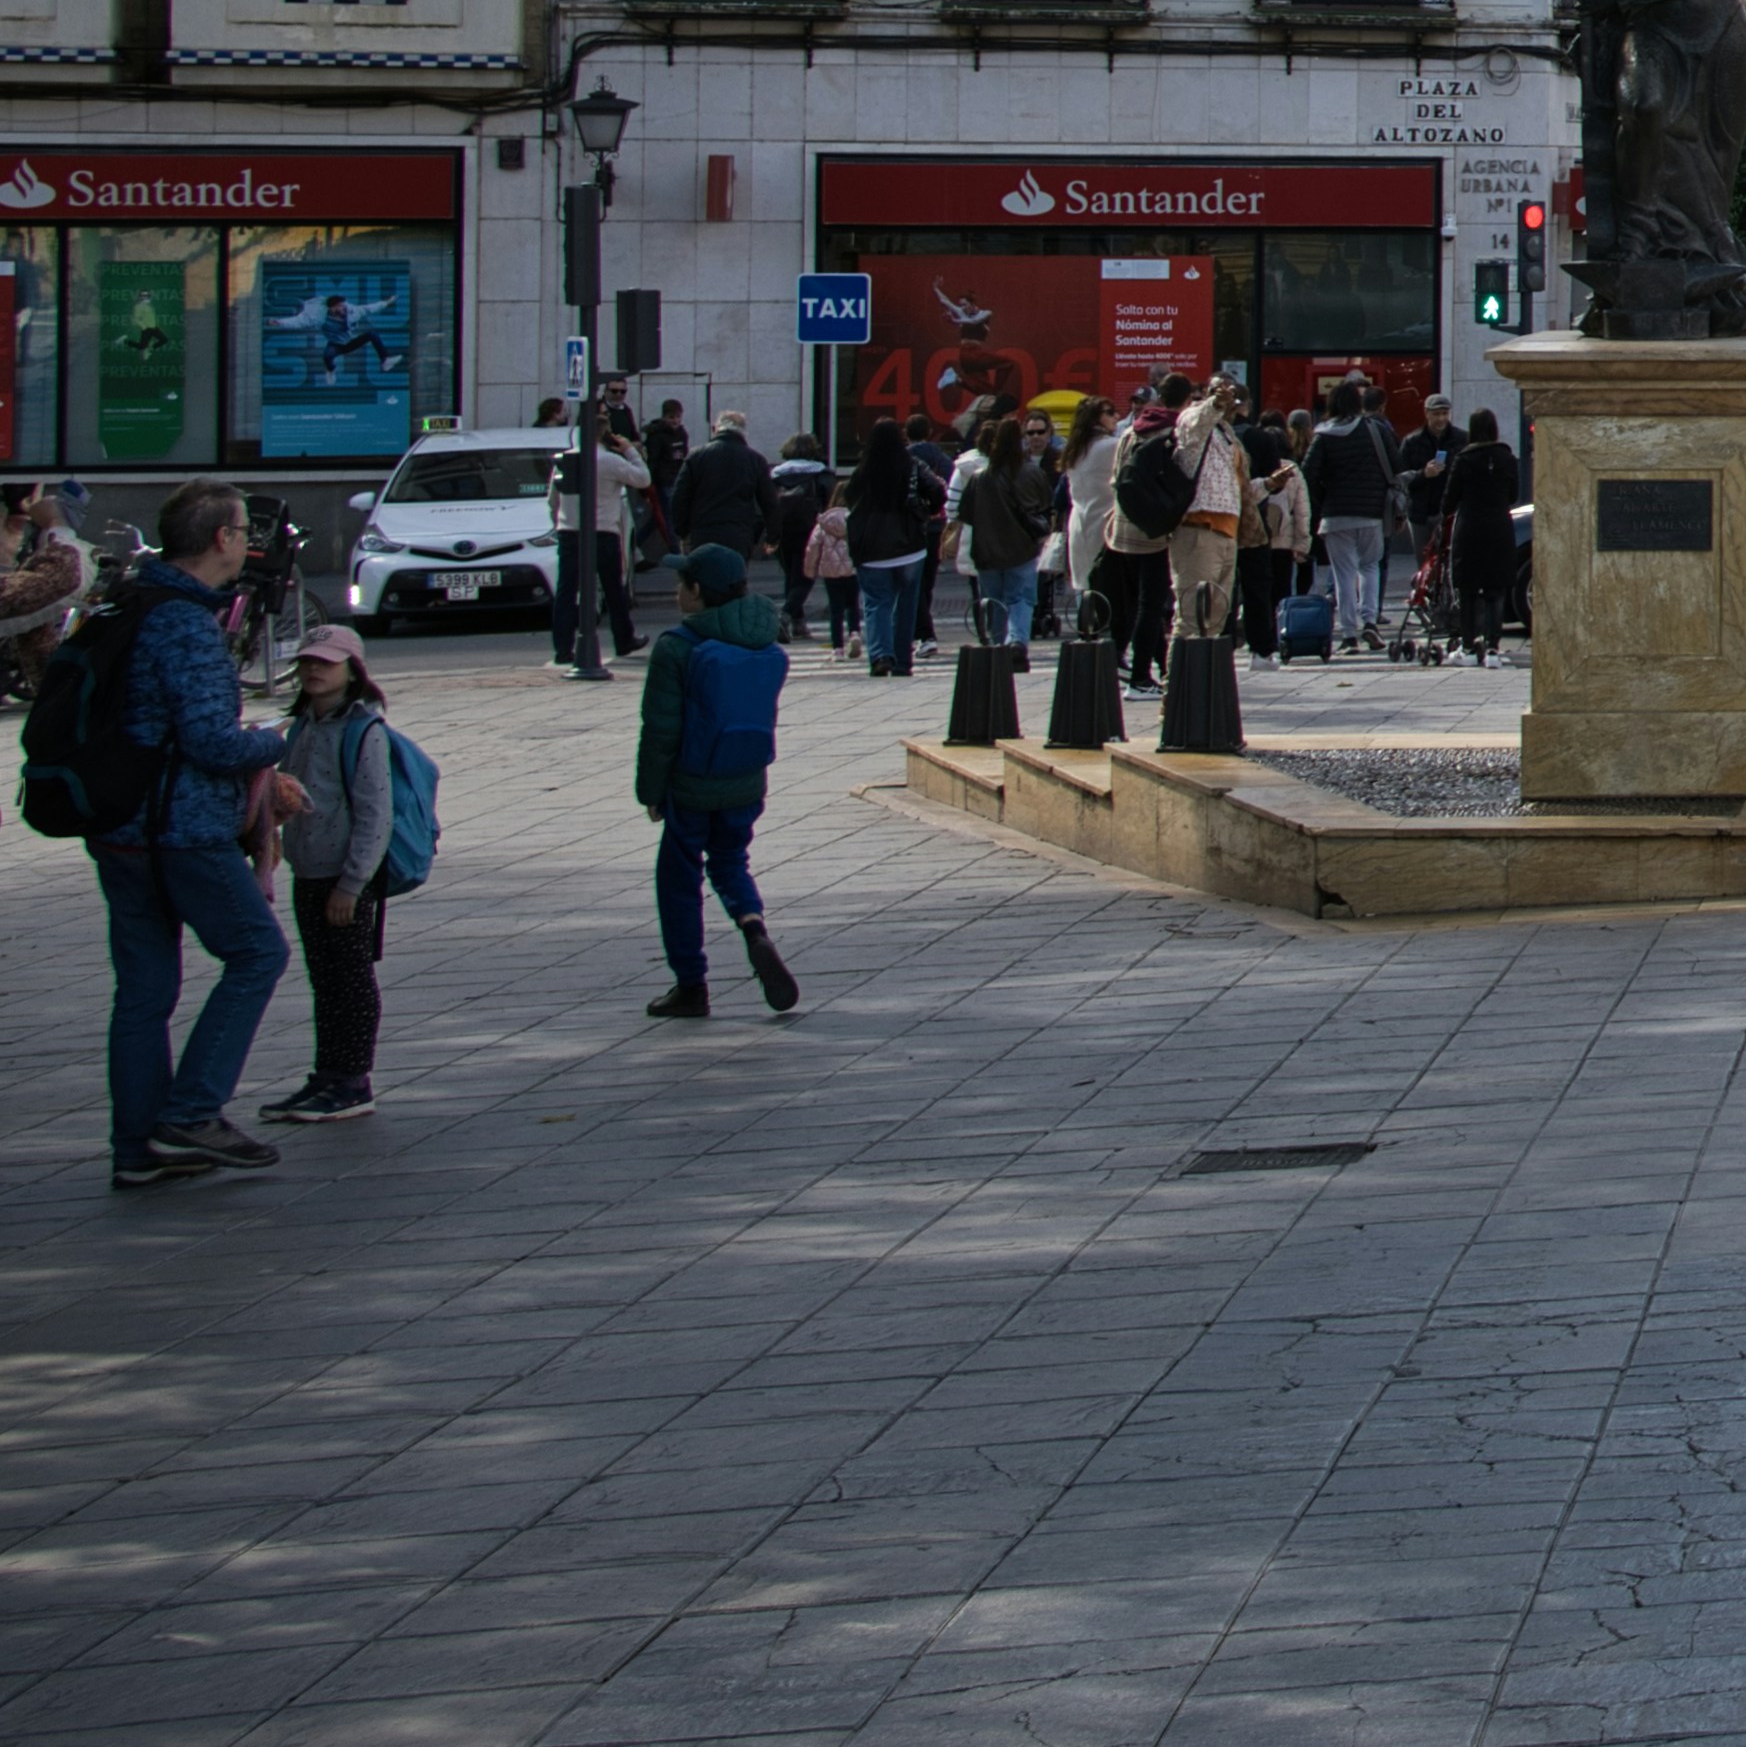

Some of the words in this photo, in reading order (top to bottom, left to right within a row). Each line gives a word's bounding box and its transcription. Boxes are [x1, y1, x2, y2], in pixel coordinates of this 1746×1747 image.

[1400, 80, 1478, 96] PLAZA
[1416, 104, 1462, 119] DEL
[1375, 127, 1504, 143] ALTOZANO
[1461, 159, 1541, 175] AGENCIA
[67, 168, 301, 208] Santander
[1460, 178, 1532, 194] URBANA
[1065, 177, 1266, 217] Santander
[1491, 233, 1510, 250] 14
[801, 297, 868, 320] TAXI
[1115, 304, 1143, 316] Salta
[1145, 306, 1165, 316] con
[1166, 305, 1178, 316] tu
[1115, 319, 1161, 331] Nómina
[1161, 320, 1173, 331] al
[1115, 334, 1174, 346] Santander
[436, 572, 472, 587] 5399
